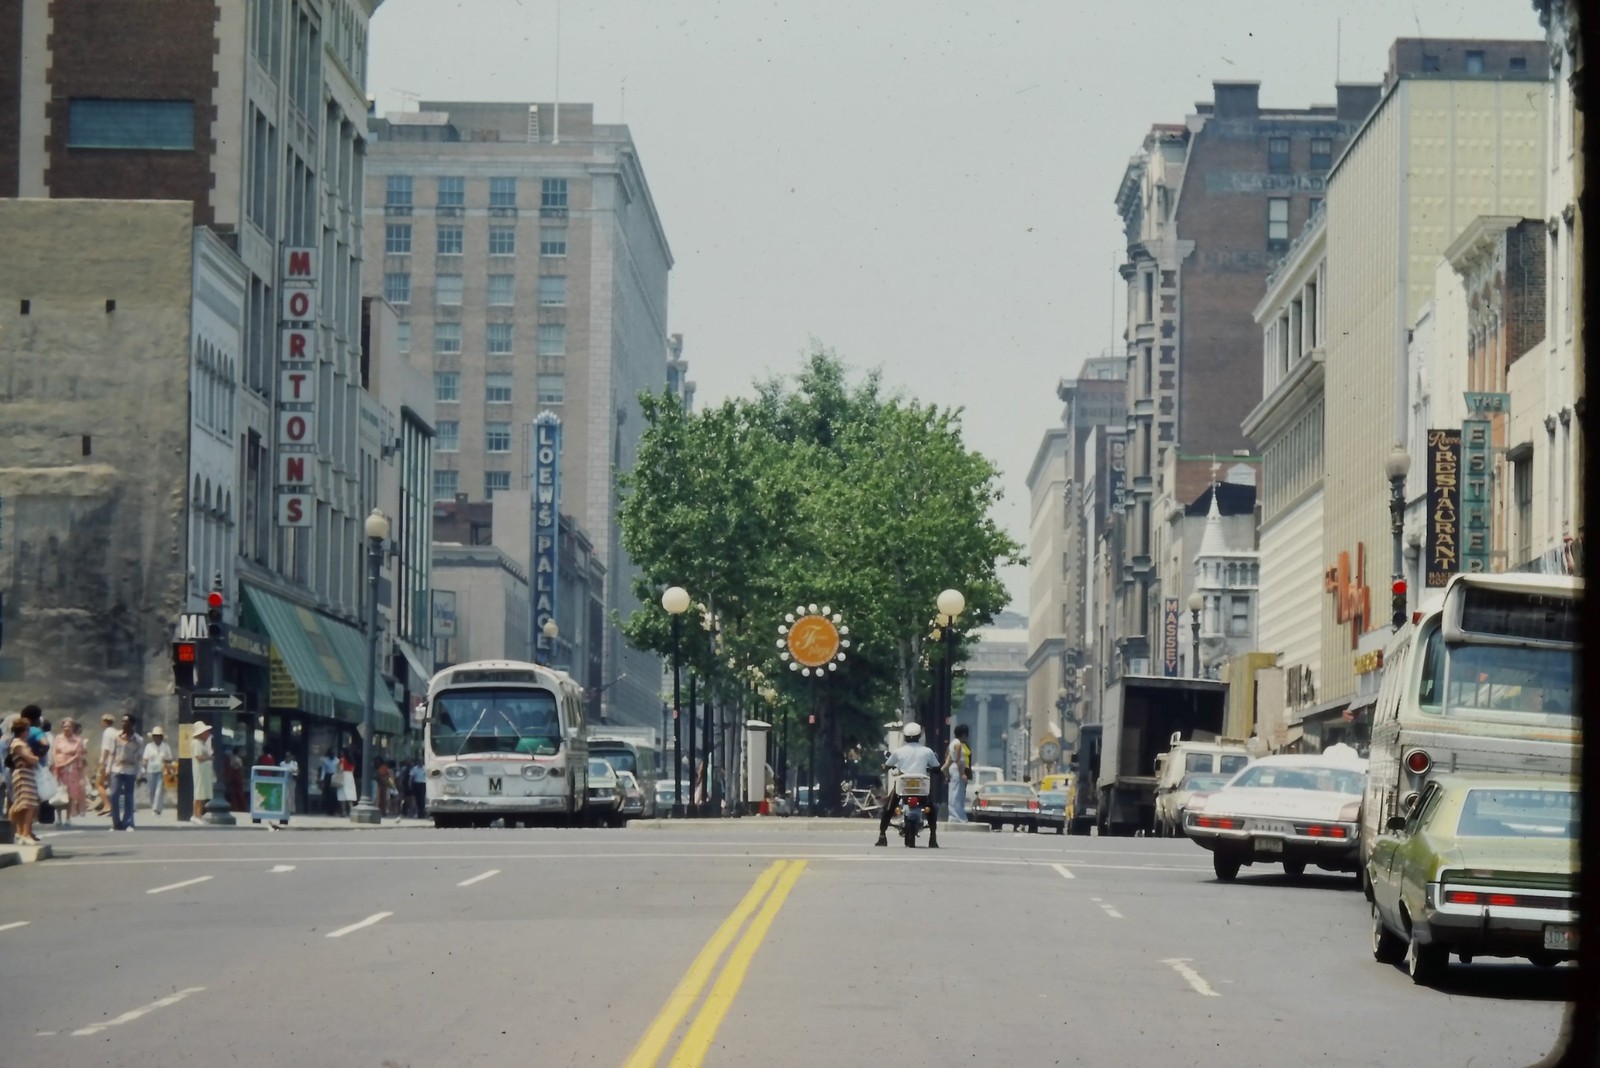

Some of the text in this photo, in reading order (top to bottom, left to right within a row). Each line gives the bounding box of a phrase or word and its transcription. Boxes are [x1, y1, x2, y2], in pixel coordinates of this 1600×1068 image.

[286, 251, 311, 522] MORTONS
[1434, 451, 1457, 570] RESTAURANT
[1469, 396, 1503, 573] THE ESTHER
[536, 535, 553, 650] PALACE
[1166, 600, 1178, 672] MASSEY
[489, 777, 502, 792] M
